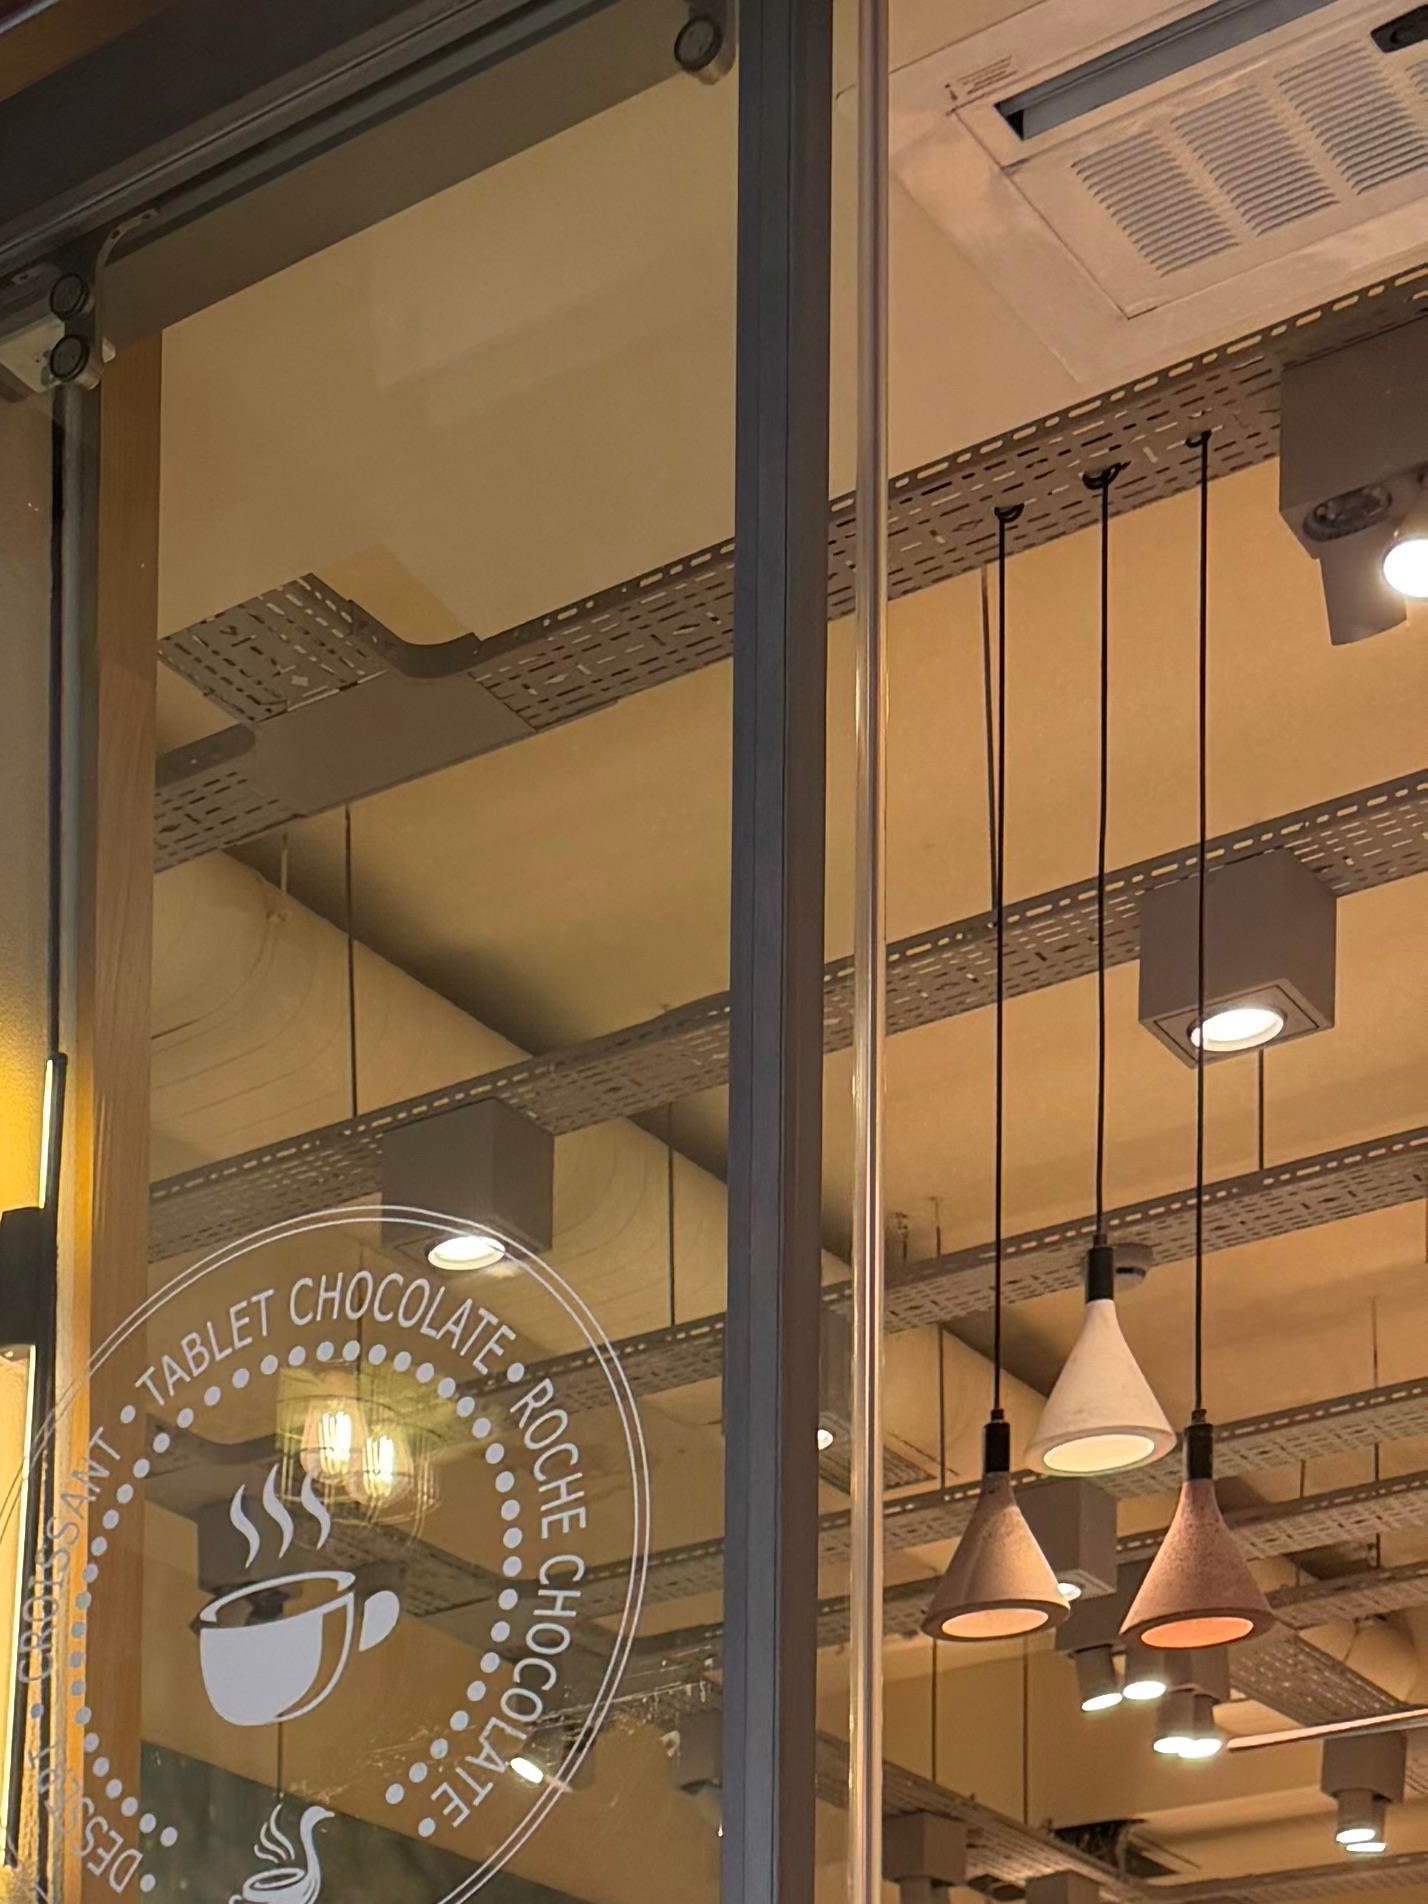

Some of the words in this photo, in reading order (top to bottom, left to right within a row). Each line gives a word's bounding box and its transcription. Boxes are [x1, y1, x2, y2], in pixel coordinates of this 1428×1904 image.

[135, 1288, 275, 1407] TABLET
[289, 1269, 517, 1376] CHOCOLATE
[18, 1425, 121, 1685] CROISSANT
[510, 1377, 587, 1540] ROCHE
[431, 1554, 587, 1828] CHOCOLATE
